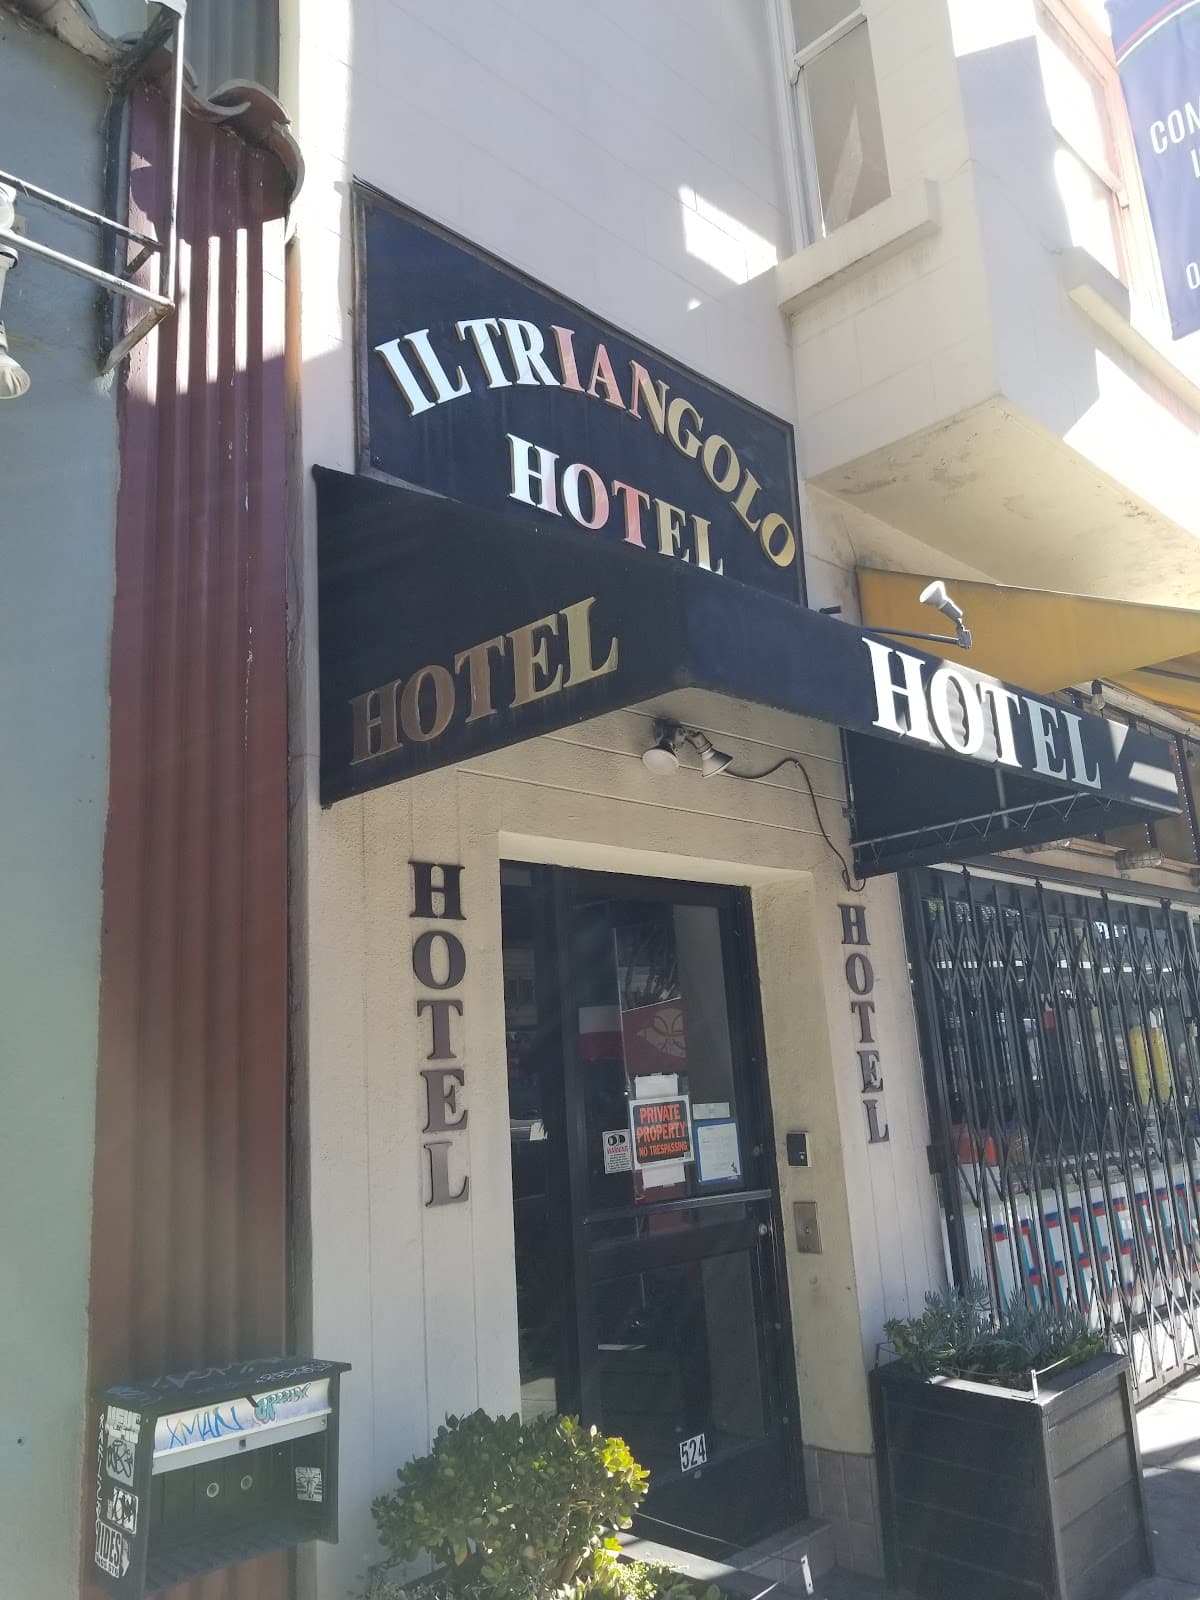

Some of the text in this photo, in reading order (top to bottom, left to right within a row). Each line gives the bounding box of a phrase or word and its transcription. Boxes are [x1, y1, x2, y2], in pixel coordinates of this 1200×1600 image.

[374, 317, 796, 568] IL TRIANGOLO
[506, 433, 723, 576] HOTEL
[349, 596, 619, 765] HOTEL
[861, 636, 1101, 789] HOTEL
[408, 861, 470, 1207] HOTEL
[837, 903, 890, 1144] HOTEL
[636, 1121, 687, 1143] PROPERTY
[638, 1141, 688, 1157] NO TRESPASSING
[640, 1104, 680, 1124] PRIVATE
[681, 1435, 706, 1469] 524
